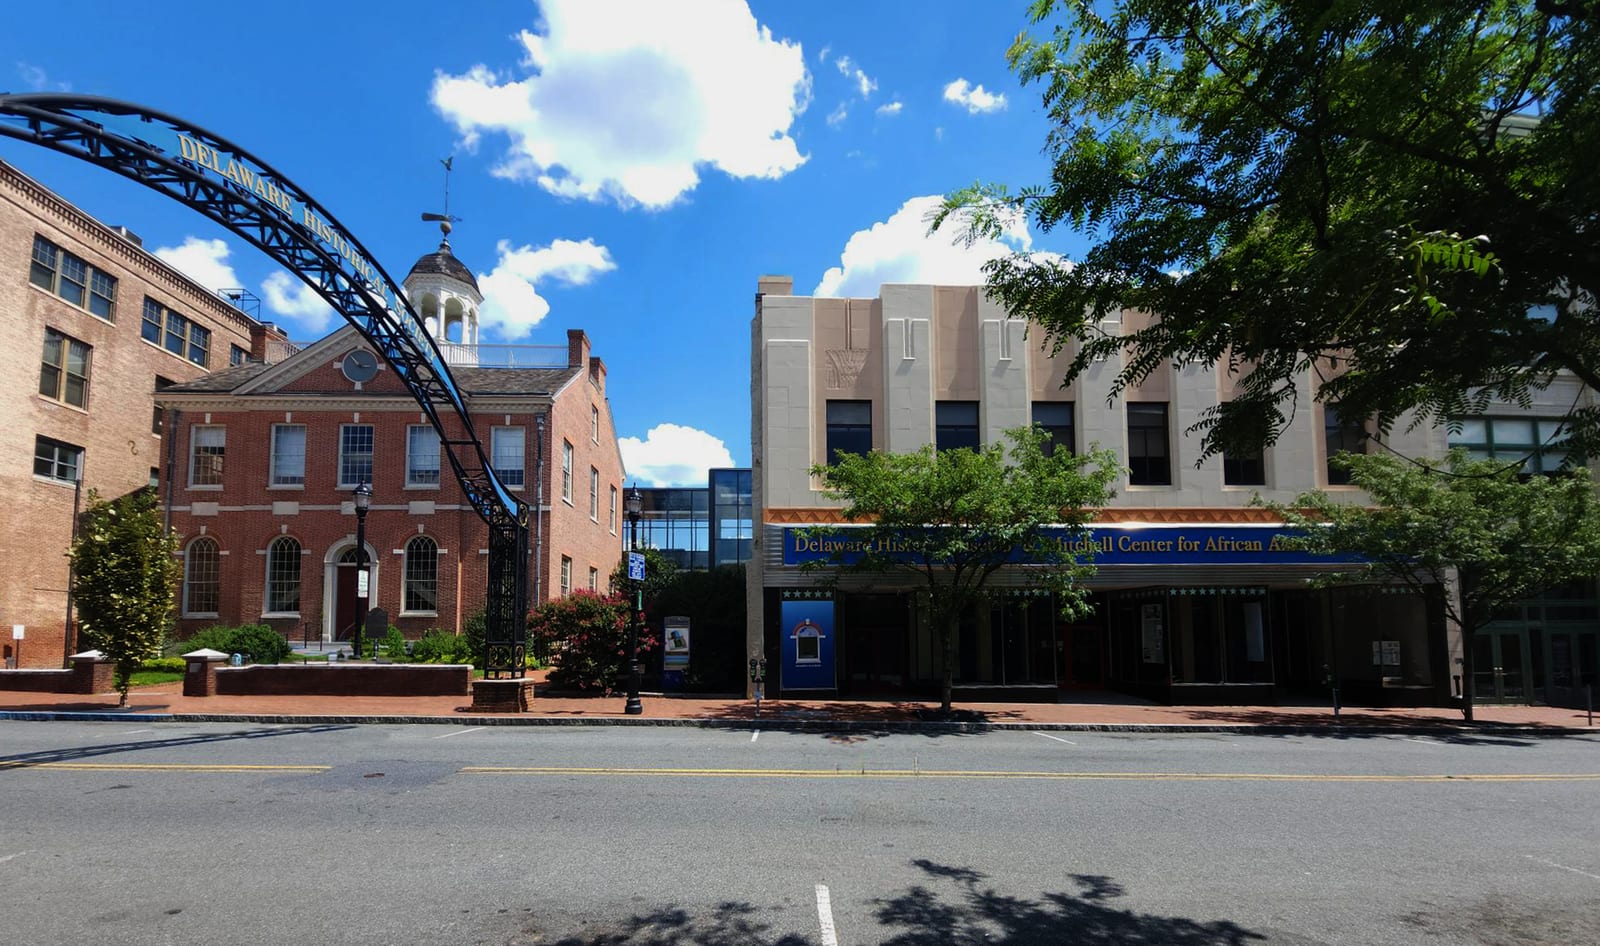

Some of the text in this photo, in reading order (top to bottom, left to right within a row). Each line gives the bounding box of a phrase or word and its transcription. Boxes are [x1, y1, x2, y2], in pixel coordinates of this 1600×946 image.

[178, 133, 437, 359] DELAWARE HISTORICAL SOCIETY
[795, 536, 871, 552] Delaware
[1118, 536, 1173, 552] Center
[1178, 536, 1200, 551] for
[1204, 536, 1262, 551] African
